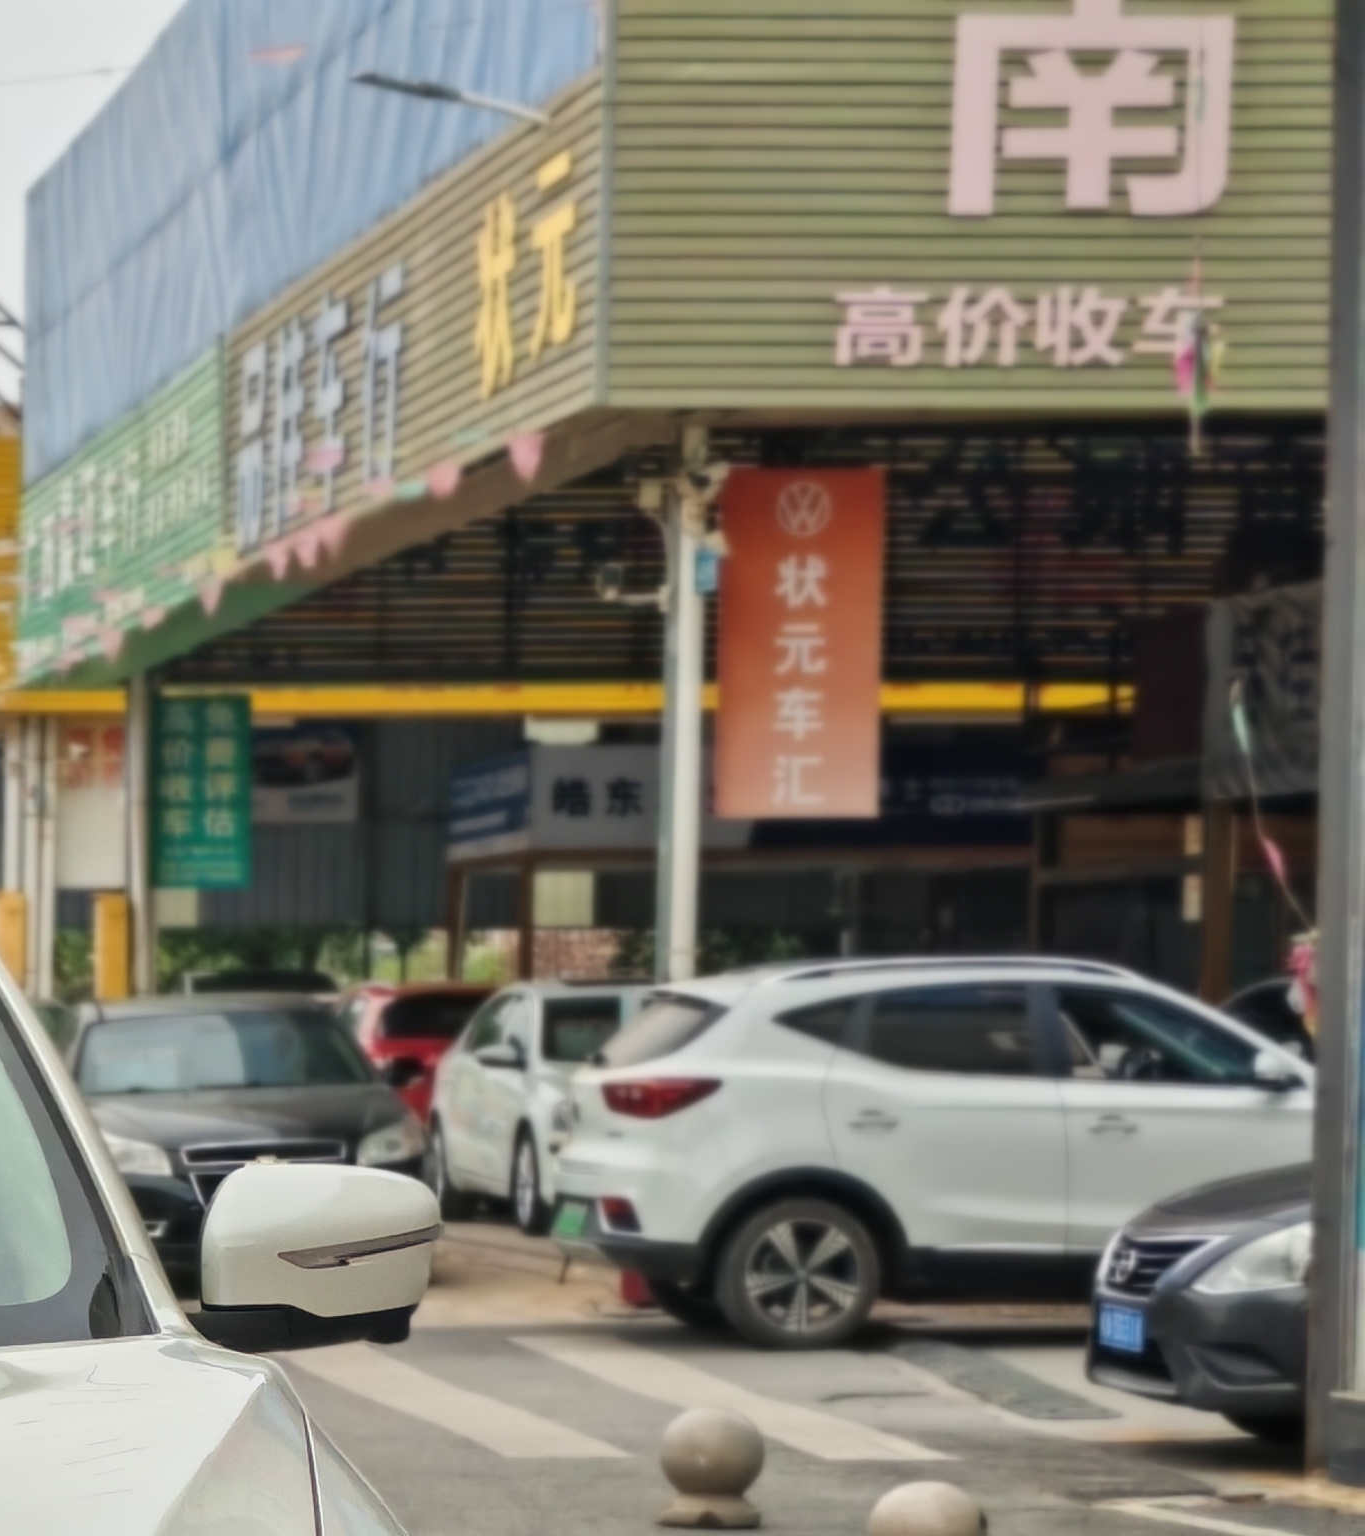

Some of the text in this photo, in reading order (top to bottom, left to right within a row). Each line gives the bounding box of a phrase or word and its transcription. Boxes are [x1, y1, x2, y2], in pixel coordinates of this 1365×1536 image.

[947, 0, 1236, 216] 南
[474, 149, 577, 398] 状元
[834, 286, 1225, 367] 高价收车
[771, 552, 830, 806] 状元车汇
